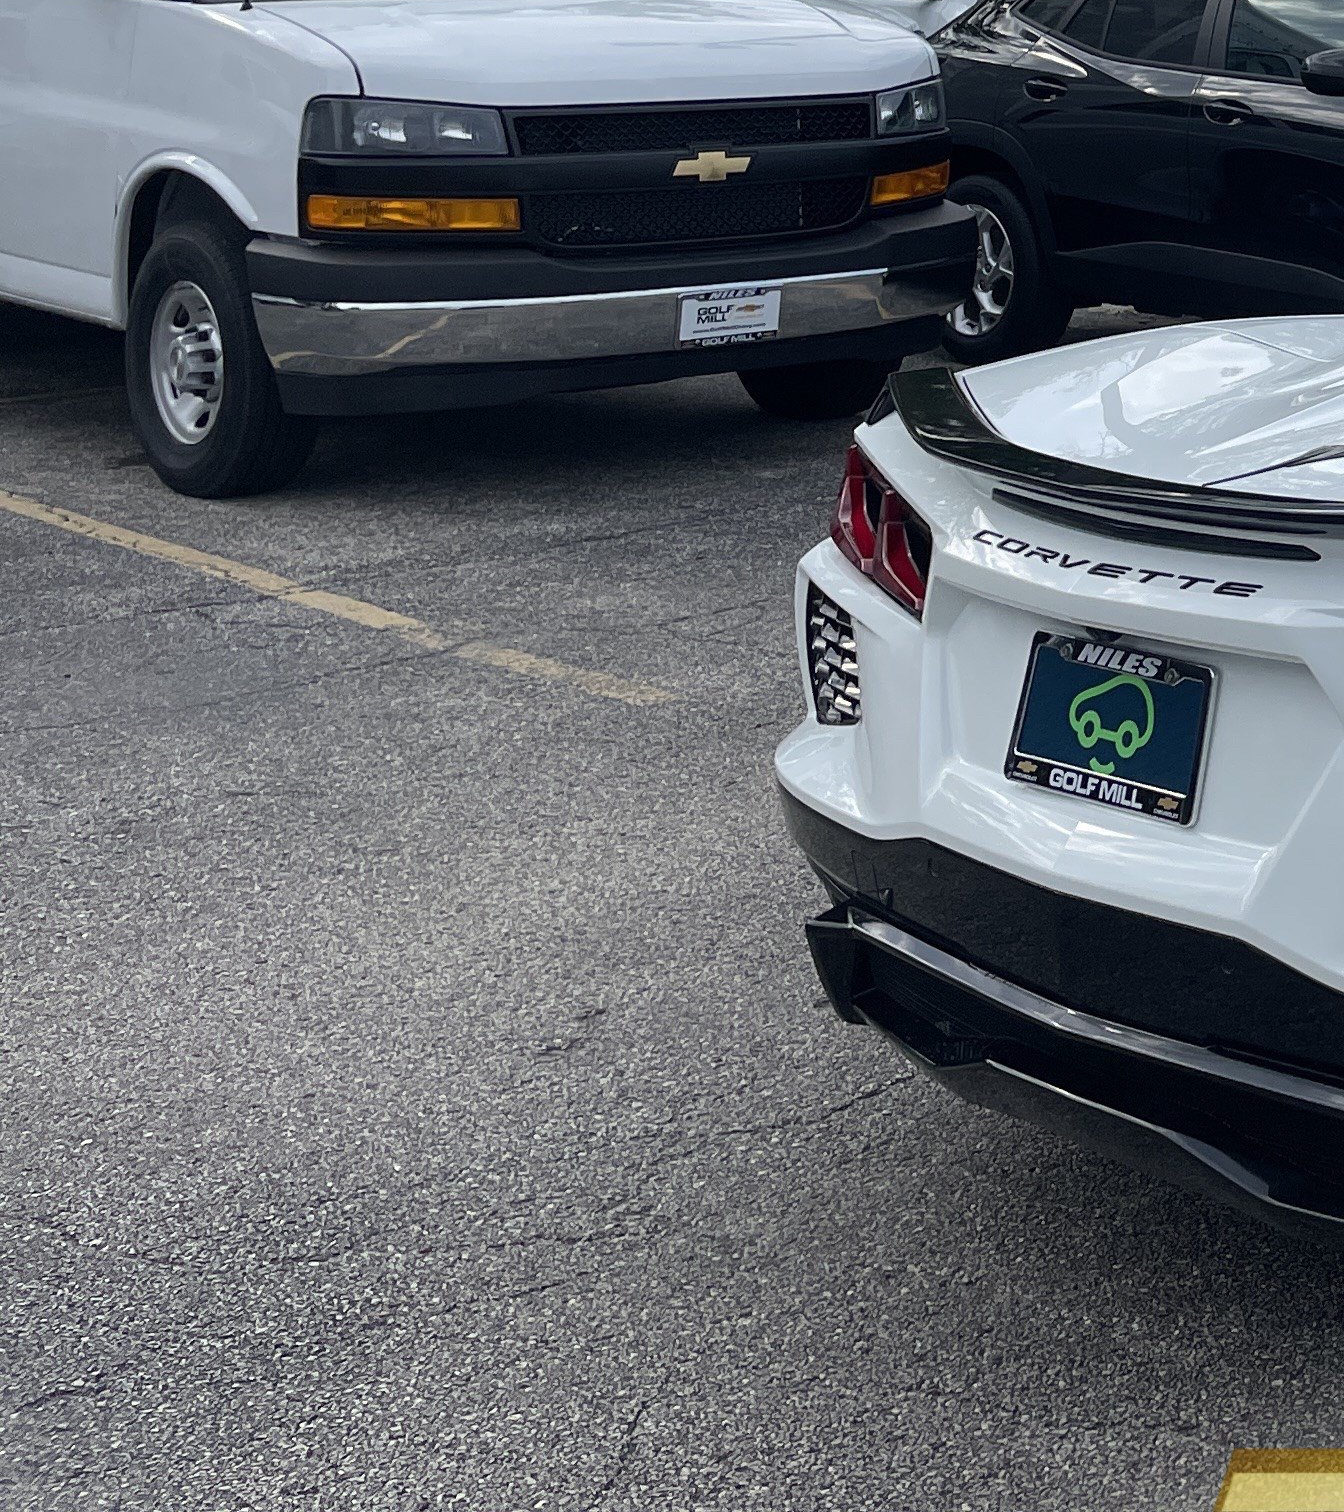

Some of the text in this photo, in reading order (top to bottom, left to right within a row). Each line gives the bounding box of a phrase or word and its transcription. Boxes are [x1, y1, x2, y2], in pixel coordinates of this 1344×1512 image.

[696, 313, 728, 325] MILL
[697, 303, 735, 315] GOLF
[702, 332, 756, 347] GOLF MILL
[972, 529, 1264, 598] CORVETTE
[1077, 643, 1162, 677] NILES
[1049, 768, 1143, 810] GOLF MILL
